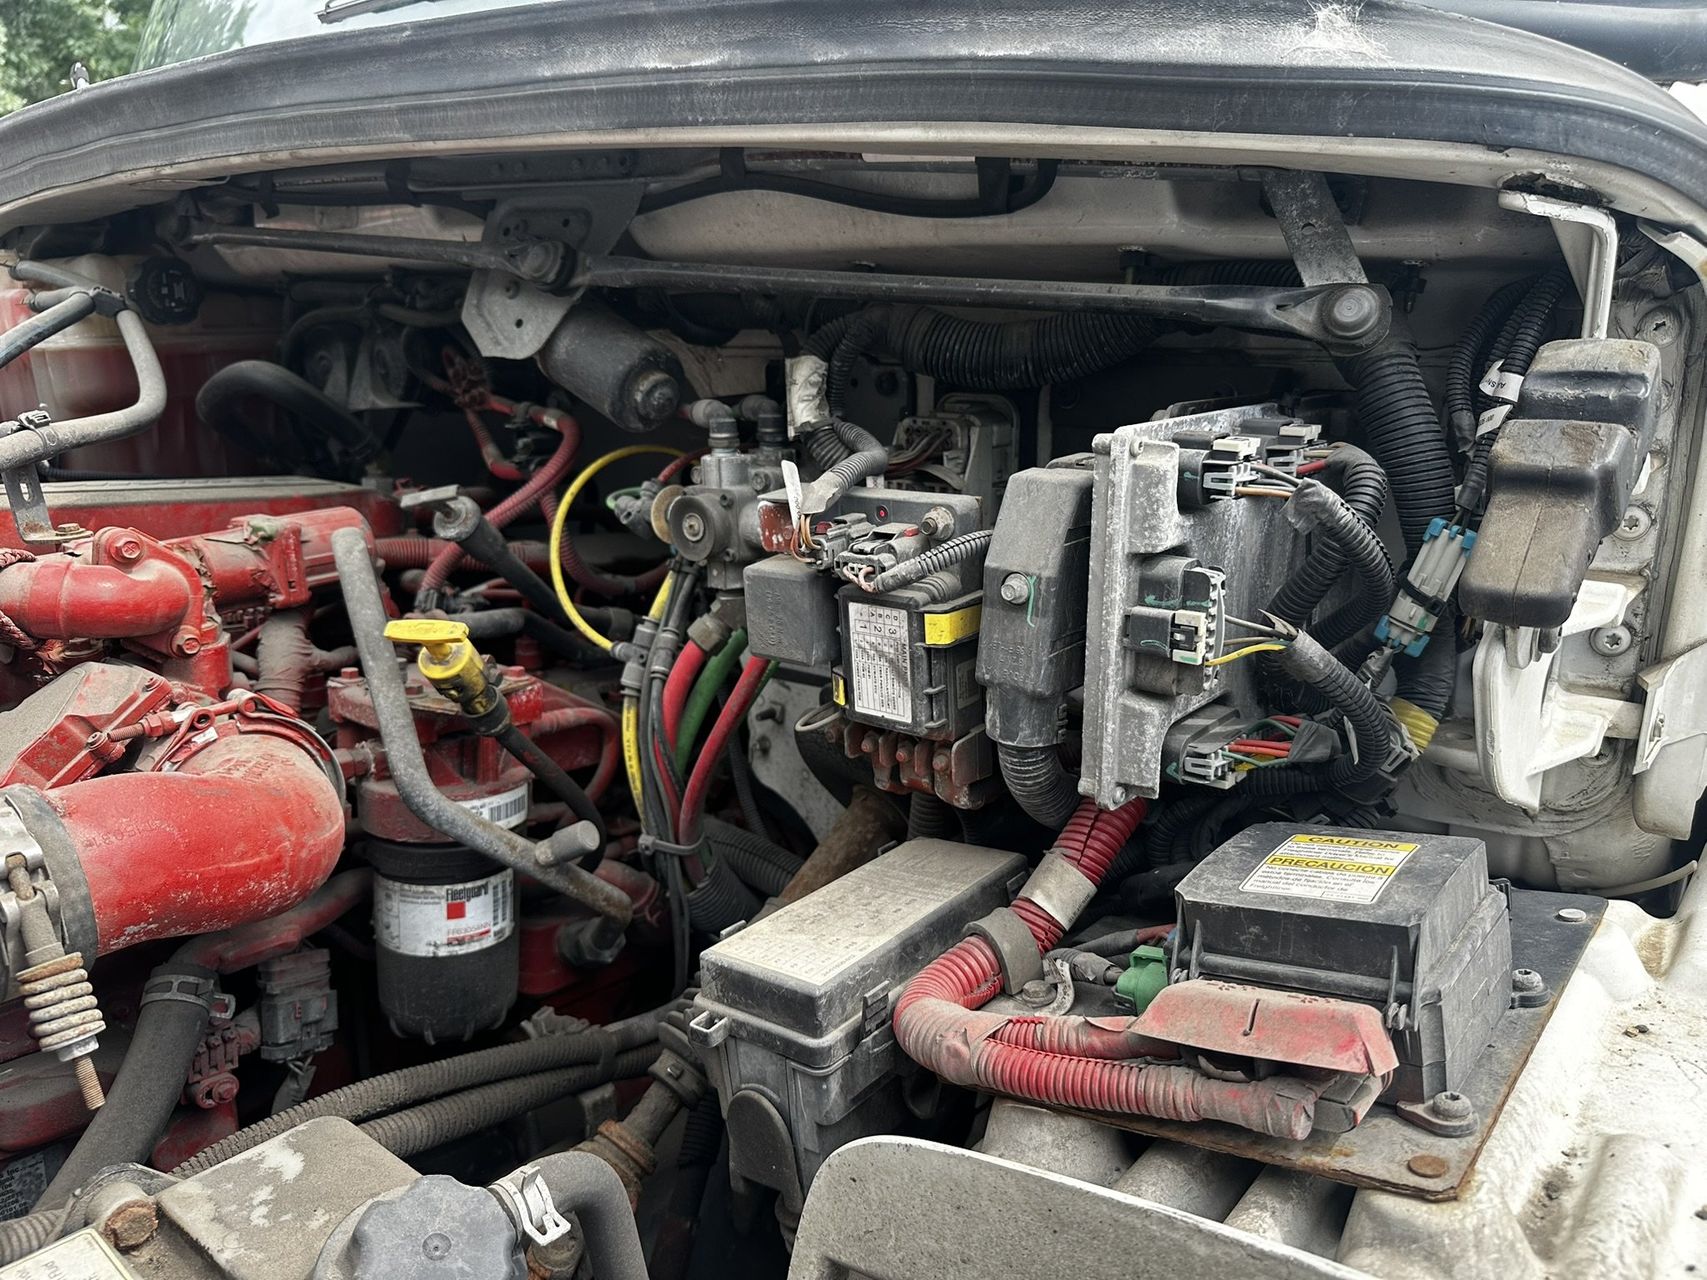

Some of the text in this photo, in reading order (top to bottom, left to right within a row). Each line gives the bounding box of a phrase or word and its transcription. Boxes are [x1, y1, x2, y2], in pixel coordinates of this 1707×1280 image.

[888, 627, 897, 635] 3
[1307, 836, 1400, 849] CAUTION
[446, 881, 489, 902] Fleetguard
